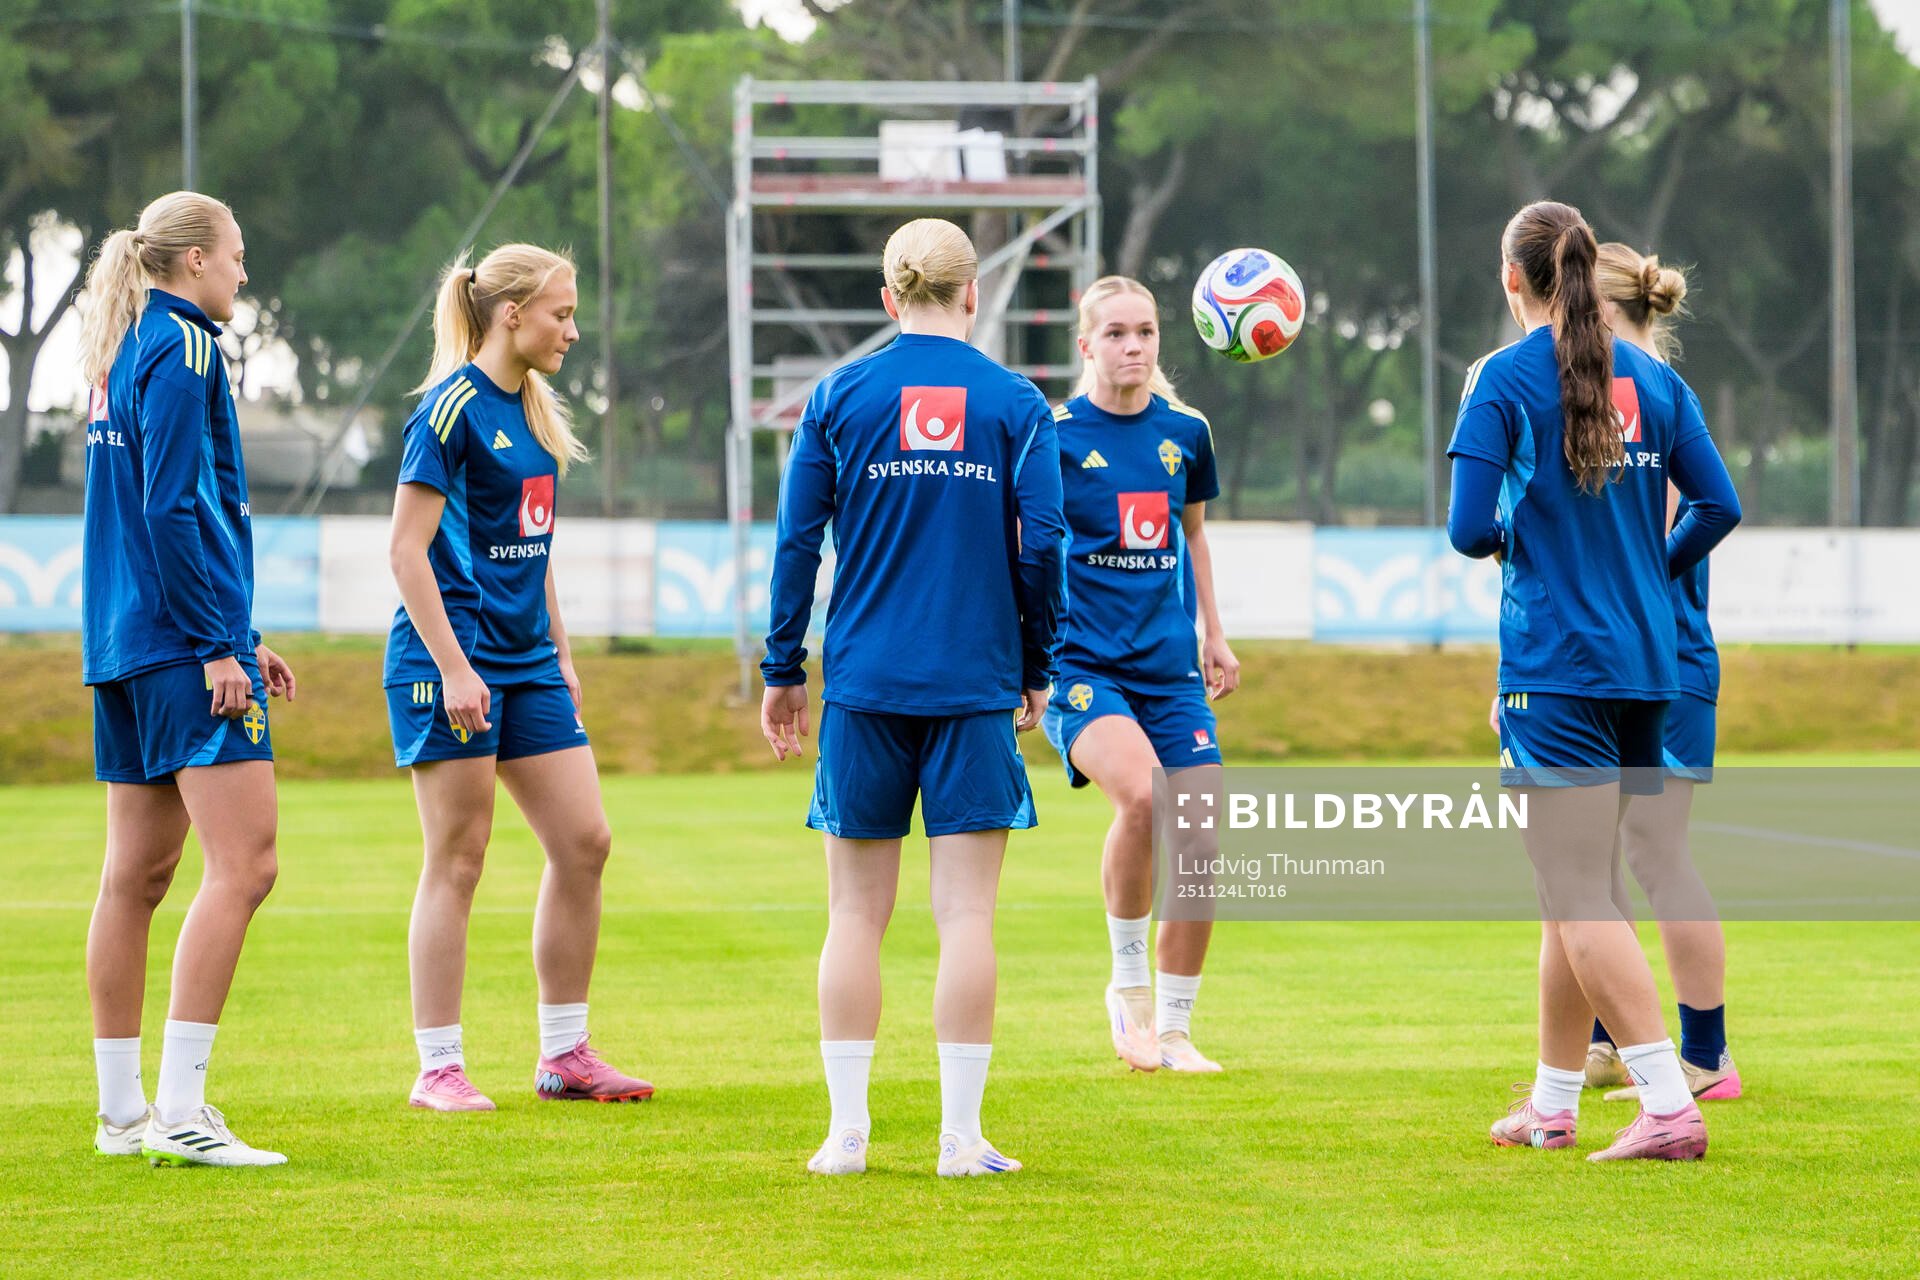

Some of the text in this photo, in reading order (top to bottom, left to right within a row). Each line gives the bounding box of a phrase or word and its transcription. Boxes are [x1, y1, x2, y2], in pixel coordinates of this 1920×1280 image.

[1636, 451, 1662, 468] SPE
[868, 459, 997, 482] SVENSKA SPEL
[1087, 554, 1177, 570] SVENSKA SP
